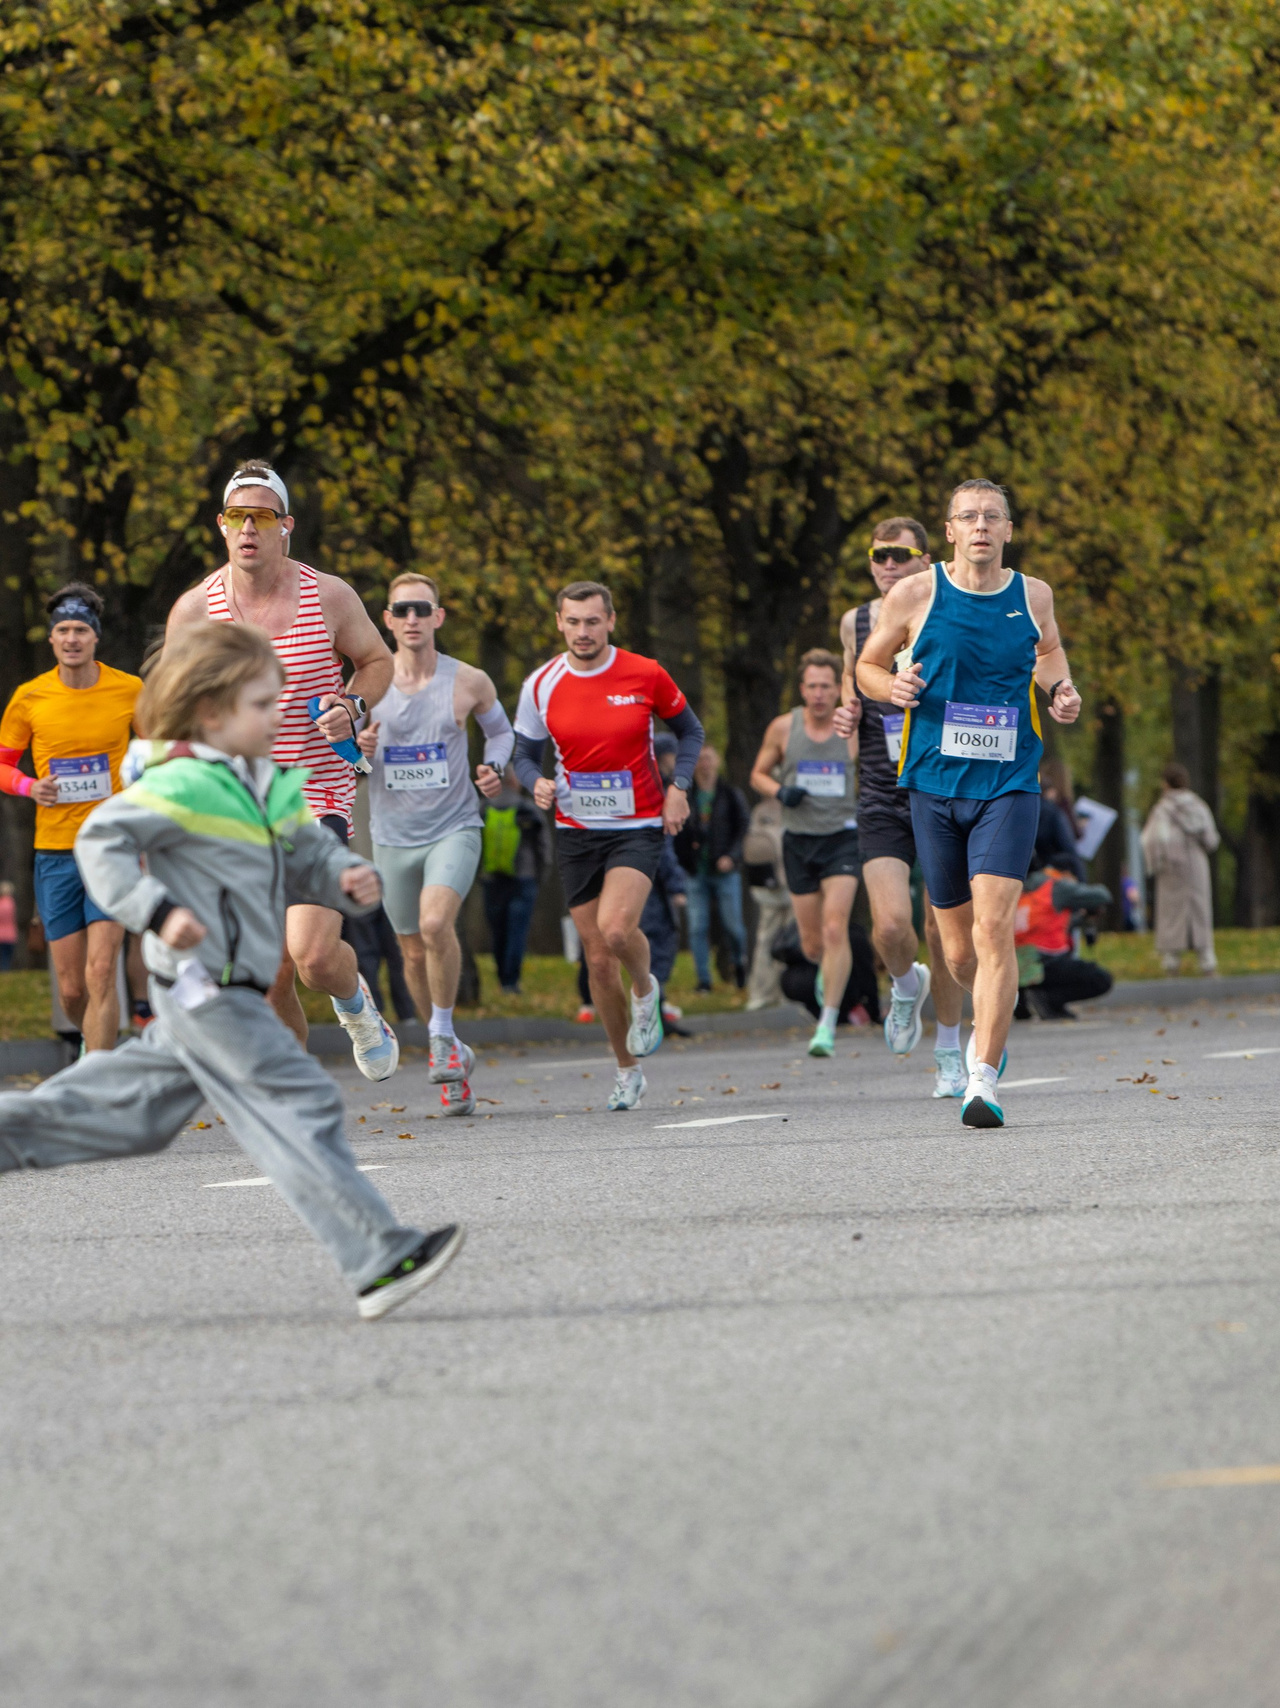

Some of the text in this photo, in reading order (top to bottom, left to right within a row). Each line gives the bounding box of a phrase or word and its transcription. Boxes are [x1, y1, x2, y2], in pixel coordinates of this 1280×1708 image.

[953, 731, 999, 748] 10801
[393, 767, 434, 781] 12889
[58, 779, 97, 793] 13344
[580, 795, 617, 808] 12678
